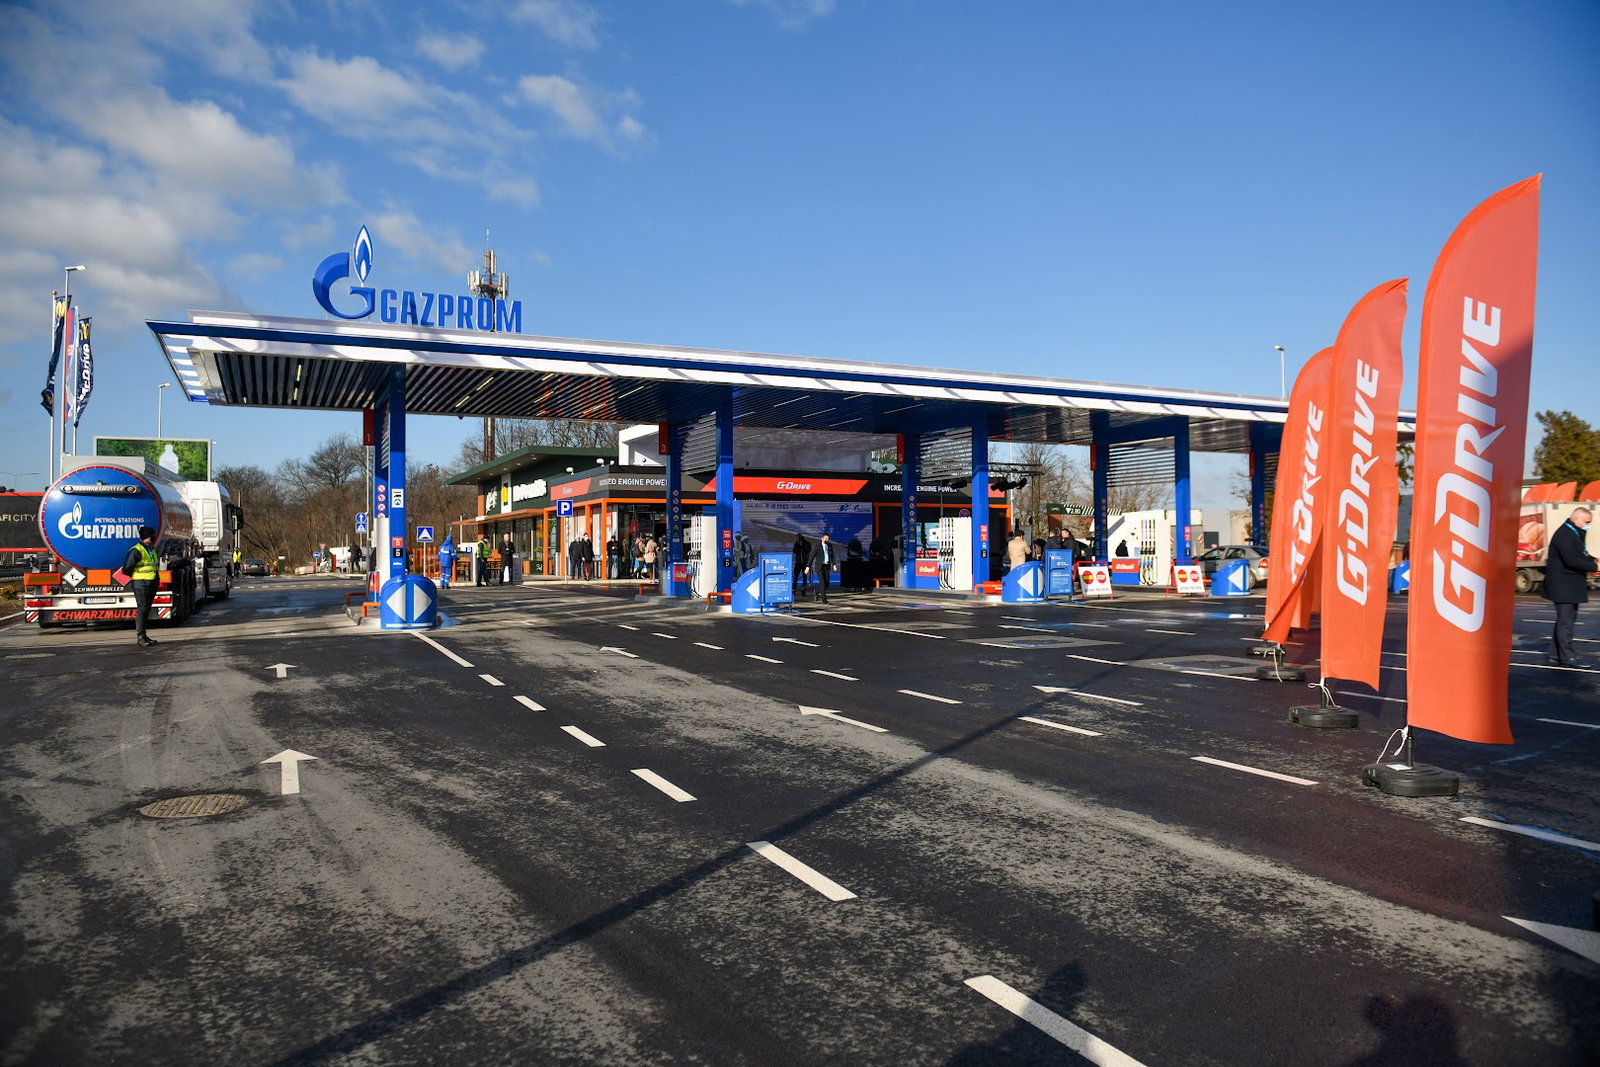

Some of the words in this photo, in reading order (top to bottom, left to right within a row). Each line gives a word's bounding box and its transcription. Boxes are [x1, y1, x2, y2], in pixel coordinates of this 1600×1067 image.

[380, 289, 523, 333] GAZPROM
[618, 478, 645, 486] ENGINE
[560, 501, 571, 514] P
[13, 514, 36, 522] CITY
[53, 609, 138, 621] SCHWARZMÜLLE
